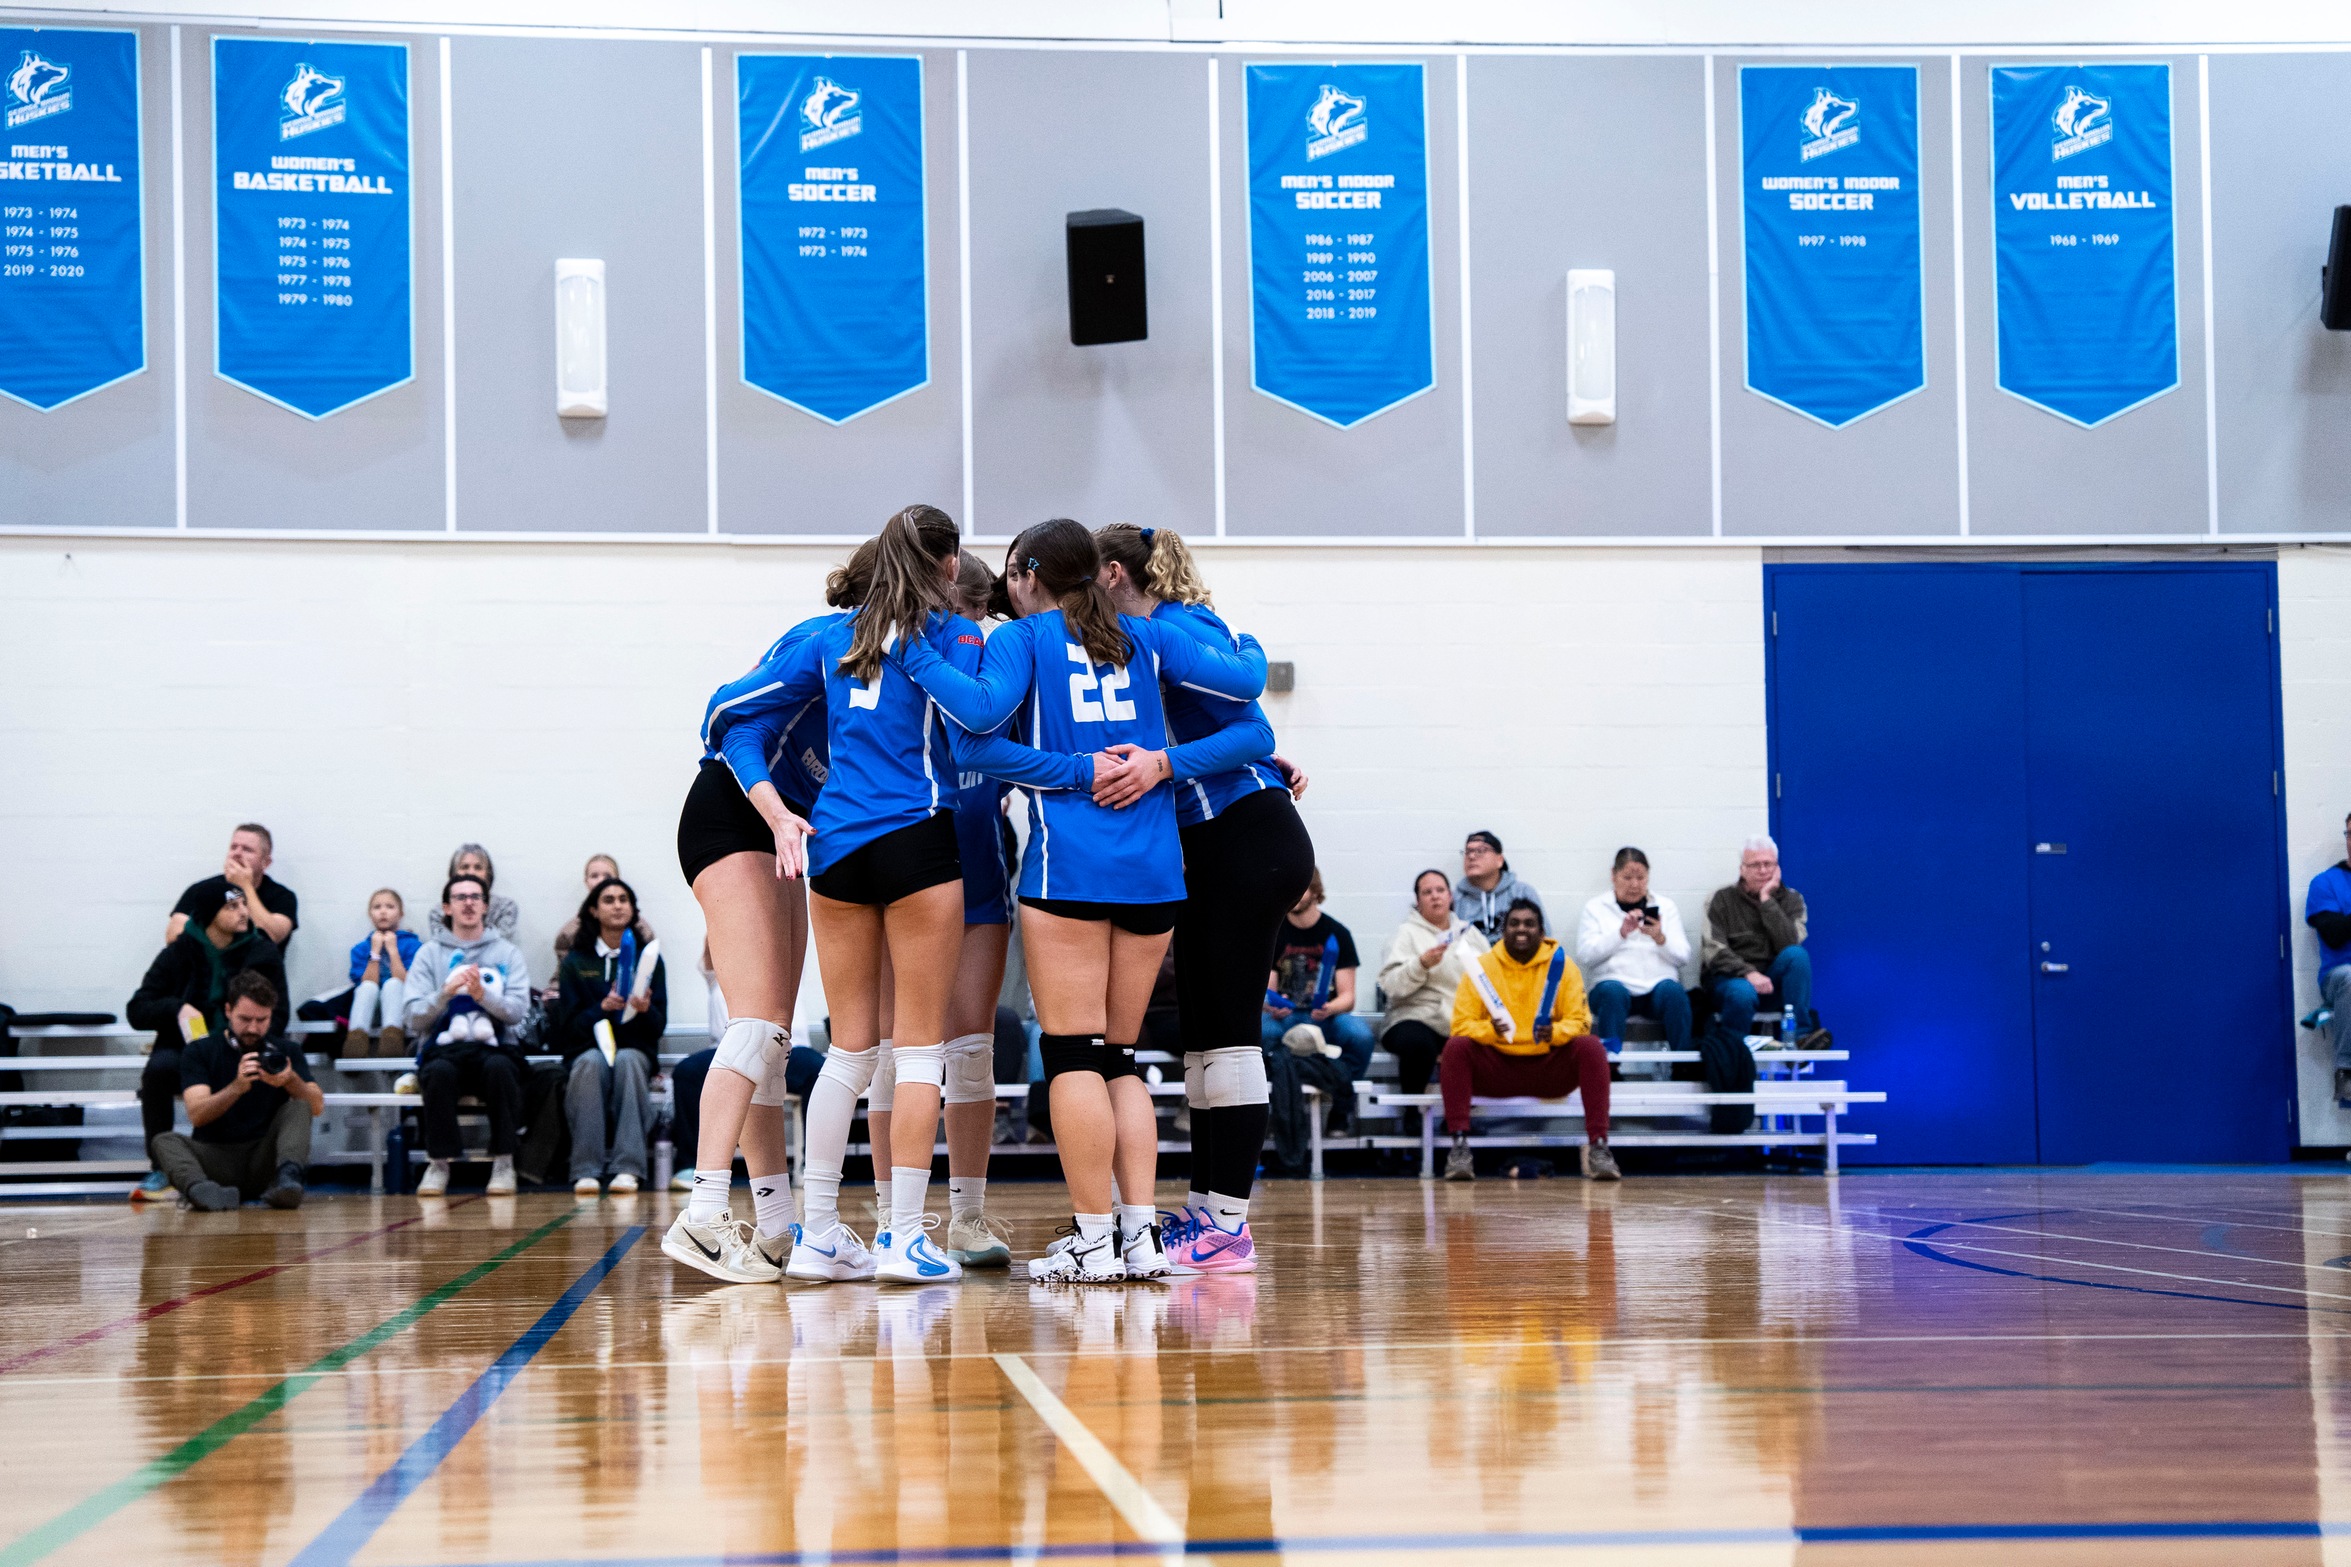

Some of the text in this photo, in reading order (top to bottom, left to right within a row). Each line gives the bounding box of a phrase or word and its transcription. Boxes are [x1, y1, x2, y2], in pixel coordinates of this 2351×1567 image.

[12, 145, 68, 158] MEN'S
[272, 156, 355, 171] WOMEN'S
[805, 168, 858, 181] MEN'S
[233, 171, 393, 195] BASKETBALL
[1281, 175, 1394, 188] MEN'S INDOOR
[1762, 177, 1899, 190] WOMEN'S INDOOR
[2057, 176, 2108, 188] MEN'S
[787, 182, 877, 203] SOCCER
[1295, 190, 1382, 210] SOCCER
[1788, 193, 1875, 211] SOCCER
[2010, 191, 2155, 210] VOLLEYBALL
[4, 207, 32, 218] 1973
[50, 208, 77, 218] 1974
[278, 218, 306, 229] 1973
[323, 219, 349, 230] 1974
[6, 226, 33, 237] 1974
[51, 227, 78, 238] 1975
[280, 237, 306, 248] 1974
[323, 238, 350, 249] 1975
[6, 245, 33, 257] 1975
[51, 246, 78, 257] 1976
[279, 256, 306, 267] 1975
[323, 257, 350, 268] 1976
[4, 265, 34, 276] 2019
[50, 265, 84, 277] 2020
[278, 274, 307, 285] 1977
[323, 276, 351, 287] 1978
[279, 294, 307, 304] 1979
[323, 294, 352, 306] 1980
[1066, 642, 1137, 723] 22
